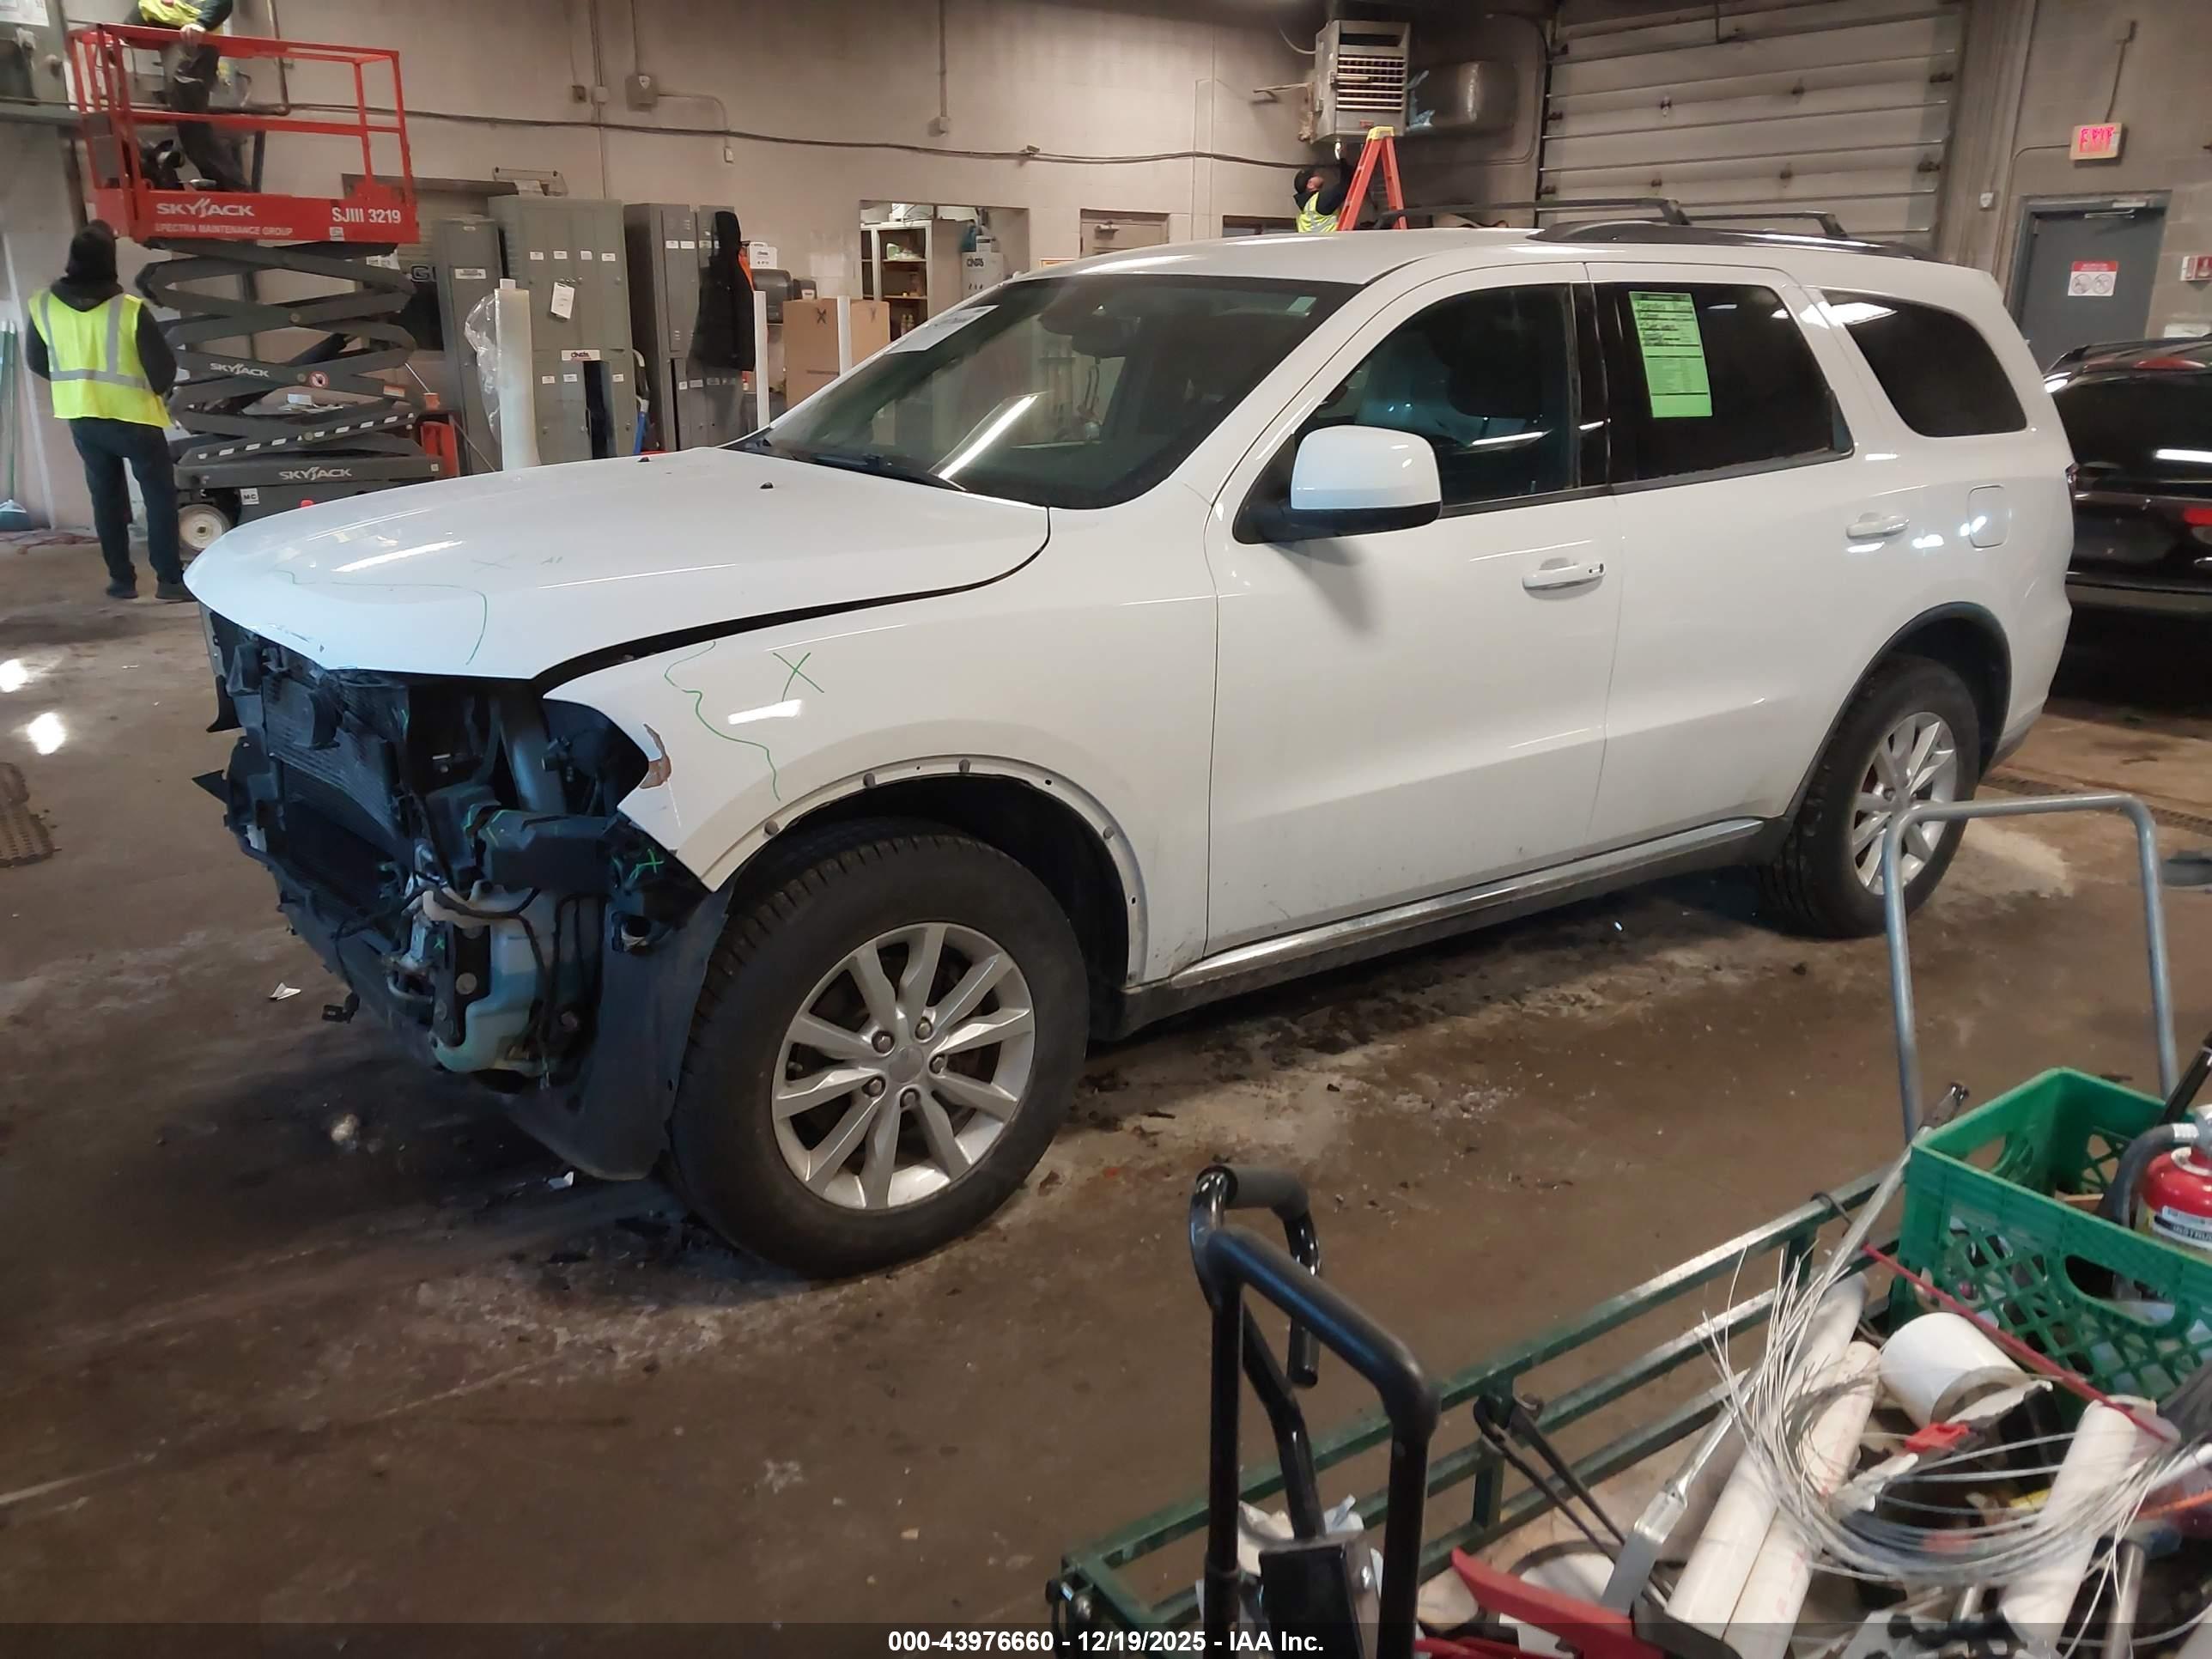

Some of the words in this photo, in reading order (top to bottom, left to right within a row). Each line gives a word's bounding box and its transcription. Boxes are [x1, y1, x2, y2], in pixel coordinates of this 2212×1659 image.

[156, 198, 254, 217] SKYJACK
[331, 207, 364, 222] SJIII
[368, 209, 401, 223] 3219
[198, 224, 260, 234] MAINTENANCE
[262, 227, 293, 236] GROUP
[210, 362, 270, 378] SKYJACK
[278, 466, 352, 481] SKYJACK
